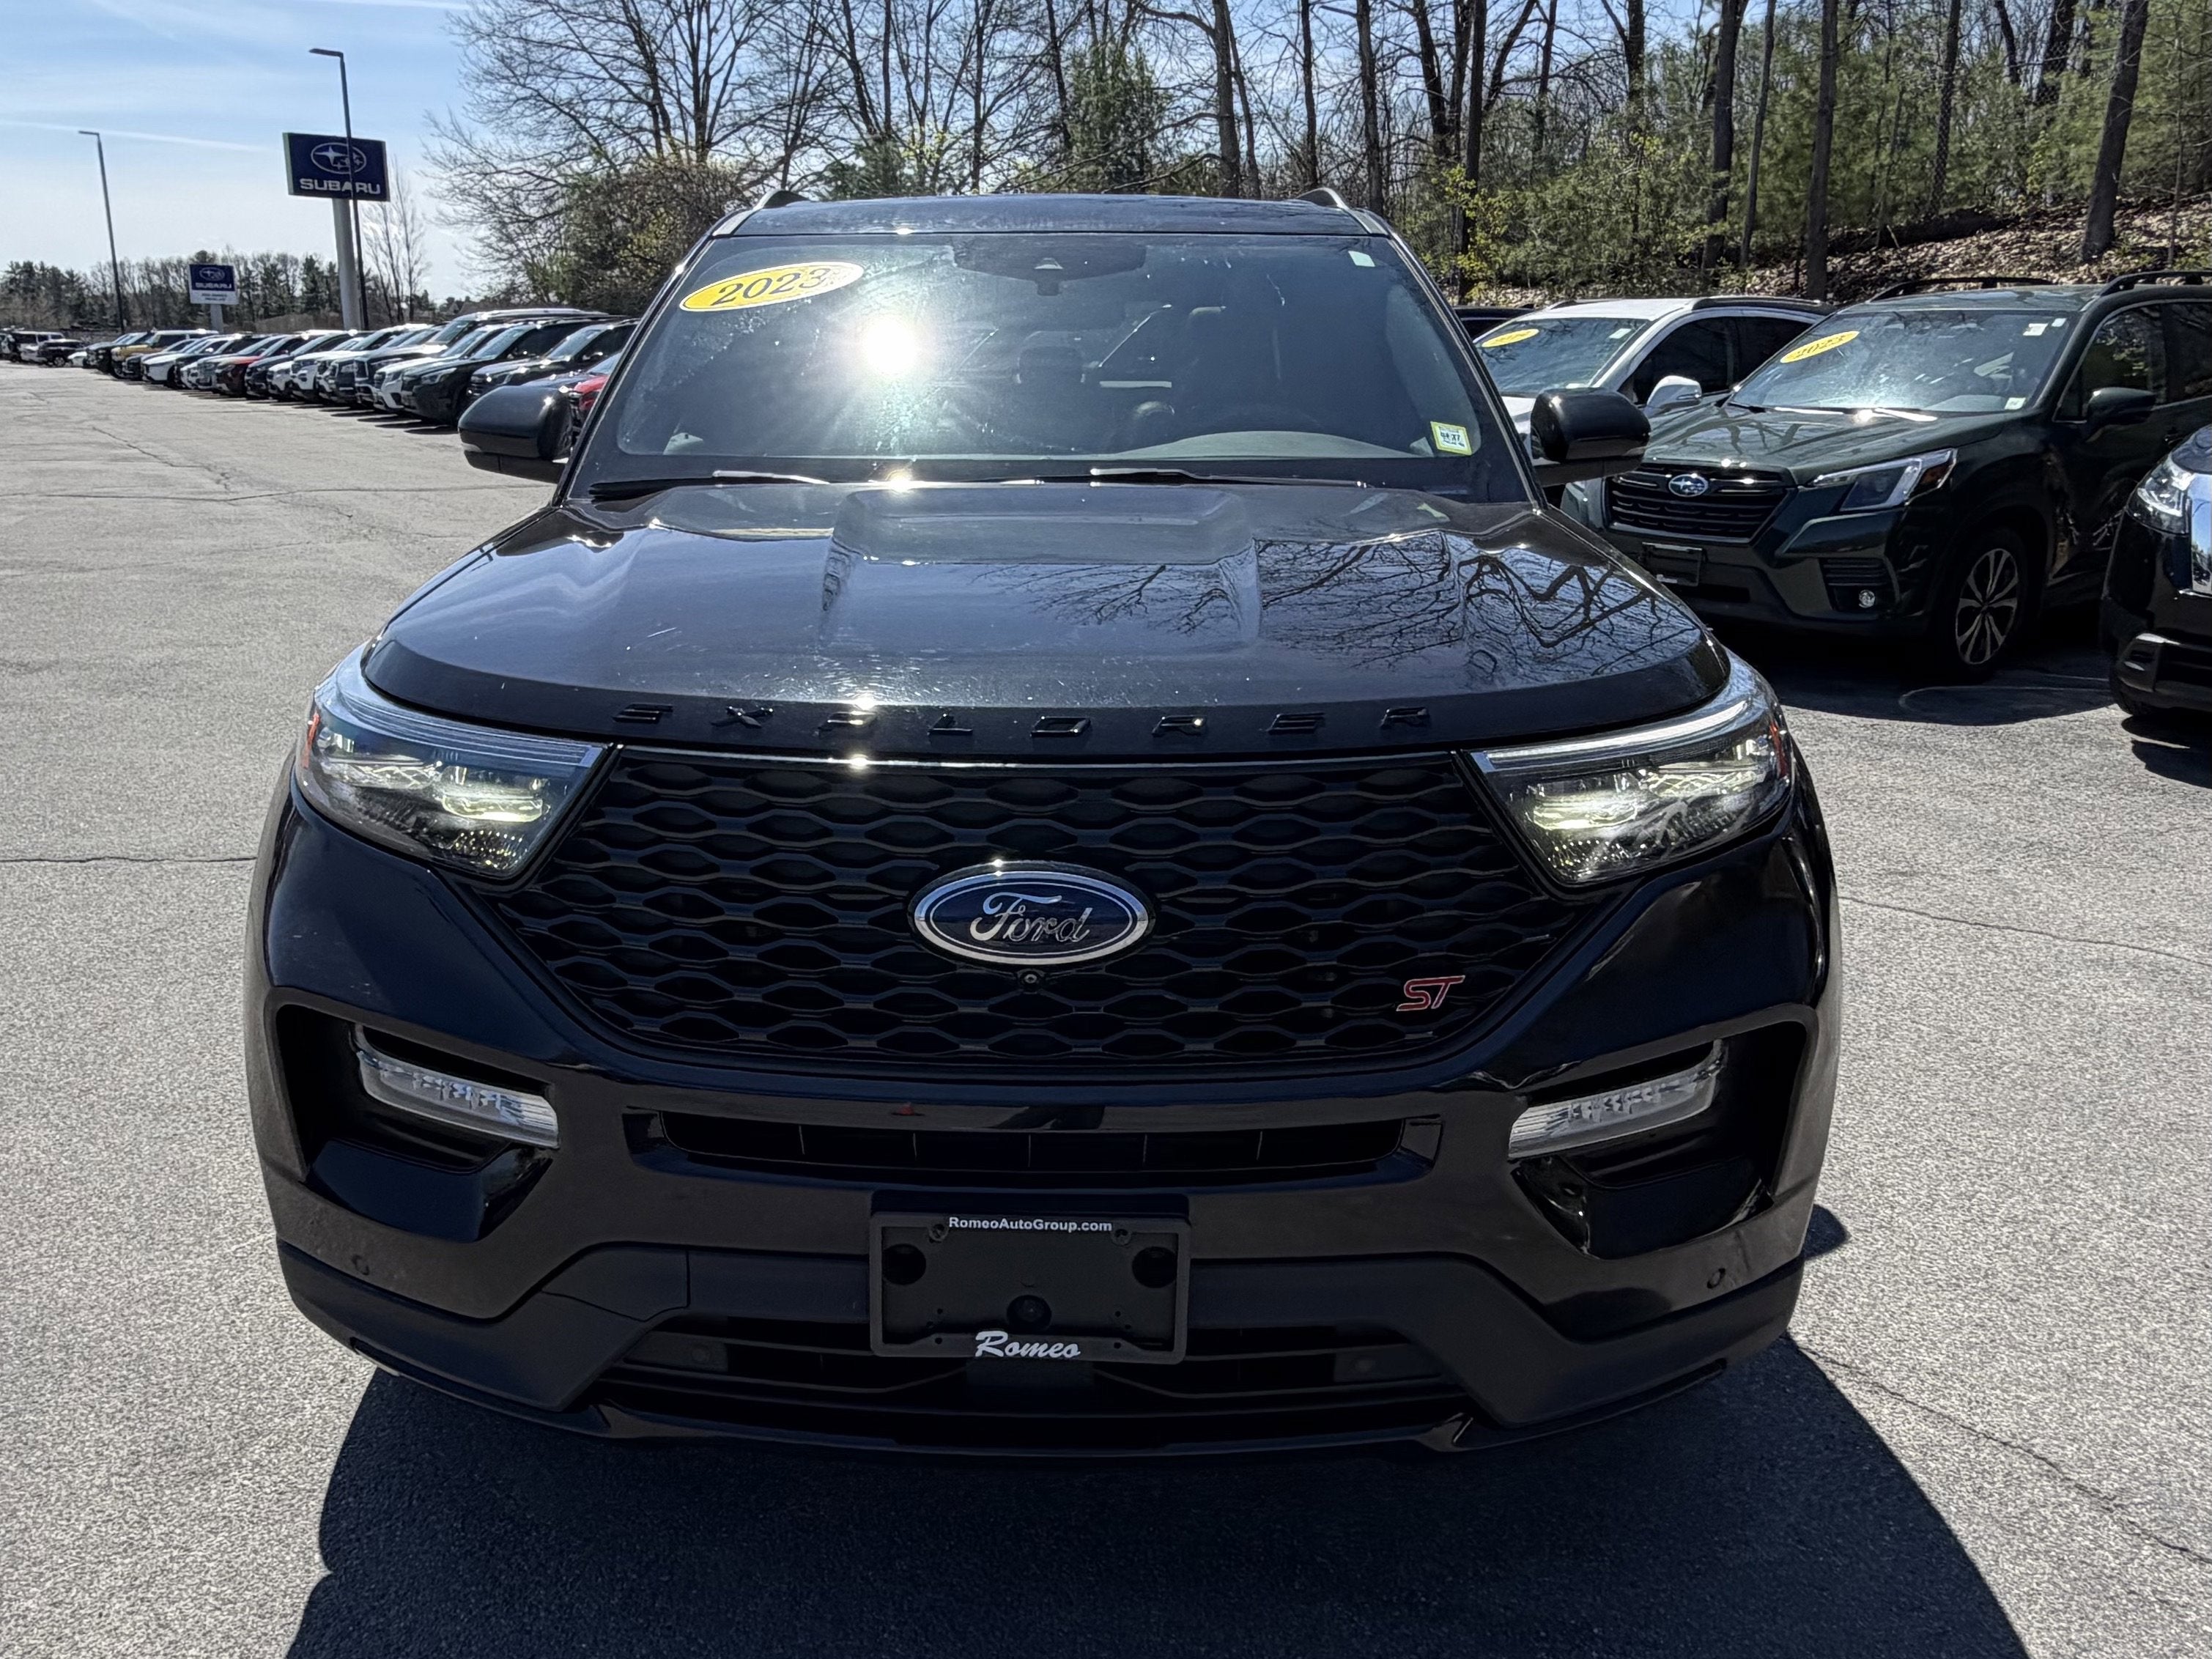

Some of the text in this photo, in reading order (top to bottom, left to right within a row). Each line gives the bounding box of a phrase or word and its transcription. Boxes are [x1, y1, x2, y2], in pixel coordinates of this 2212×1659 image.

[299, 177, 381, 195] SUBARU
[195, 281, 232, 289] SUBARU
[710, 267, 832, 306] 2023
[611, 702, 1431, 737] EXPLORER
[969, 891, 1094, 942] Ford
[1396, 975, 1466, 1012] ST
[948, 1216, 1113, 1233] RomeoAutoGroup.com
[974, 1330, 1081, 1359] Romeo
